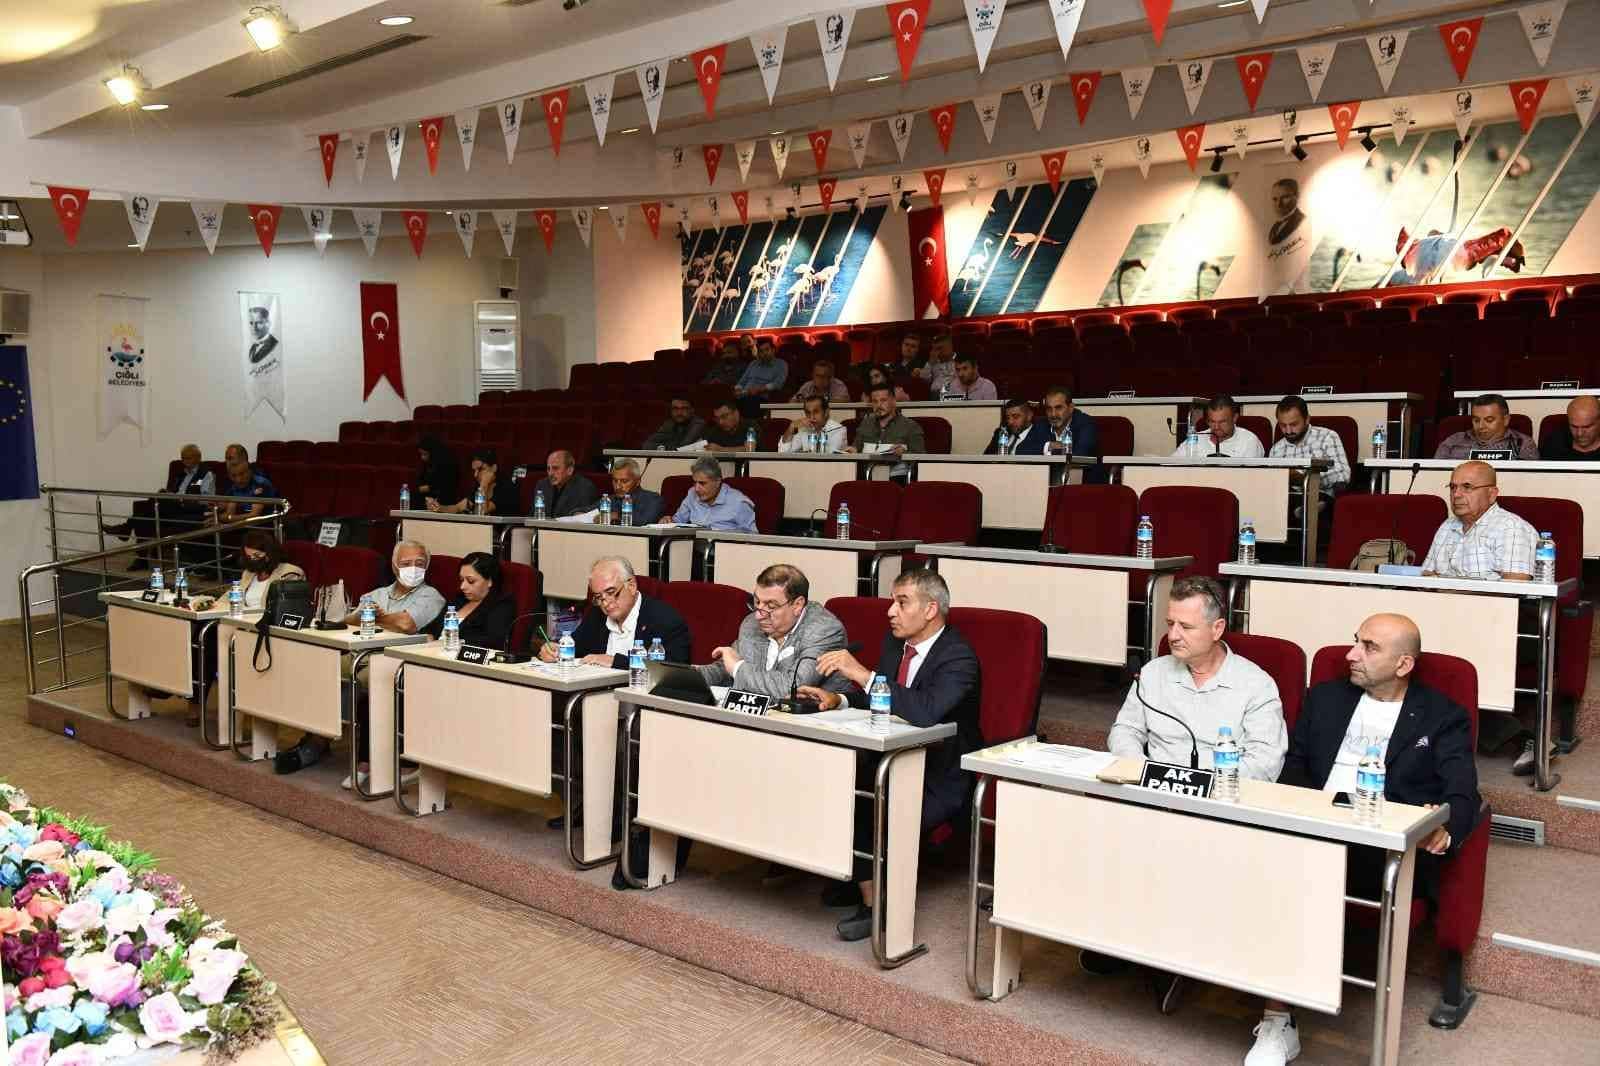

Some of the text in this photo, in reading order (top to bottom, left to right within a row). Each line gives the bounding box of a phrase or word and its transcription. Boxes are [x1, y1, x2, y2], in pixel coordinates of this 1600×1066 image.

[284, 618, 298, 626] CHP
[463, 650, 481, 660] CHP
[738, 694, 759, 705] AK
[1163, 768, 1194, 783] AK
